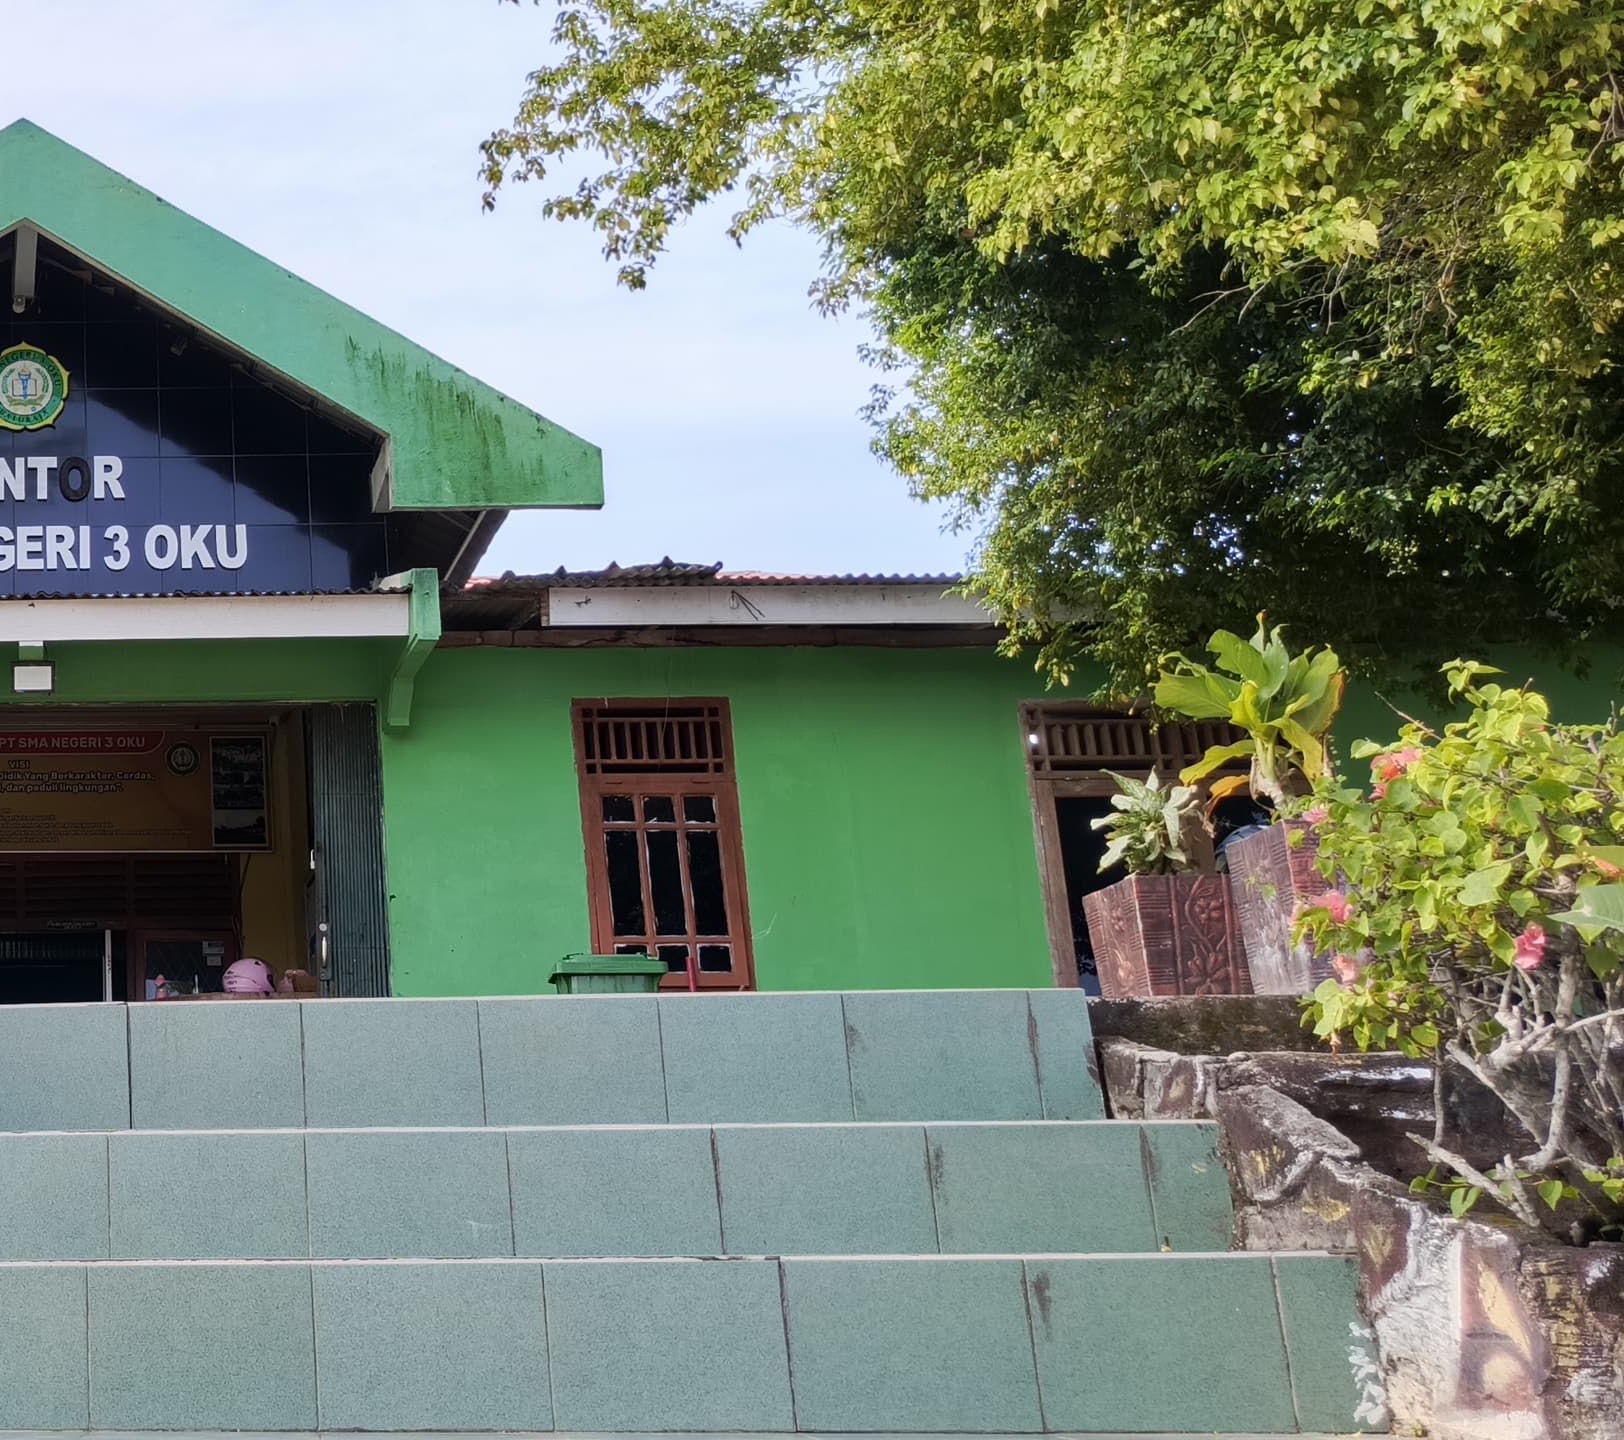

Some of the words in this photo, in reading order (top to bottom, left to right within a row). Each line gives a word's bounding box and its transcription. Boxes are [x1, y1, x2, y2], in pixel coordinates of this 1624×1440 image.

[103, 525, 130, 571] 3
[144, 523, 247, 570] OKU
[18, 737, 47, 748] SMA
[51, 736, 101, 748] NEGERI
[104, 736, 114, 748] 3
[117, 736, 146, 748] OKU
[8, 760, 30, 769] VISI
[23, 771, 49, 783] Yang
[6, 783, 25, 792] dan
[26, 783, 58, 794] peduli
